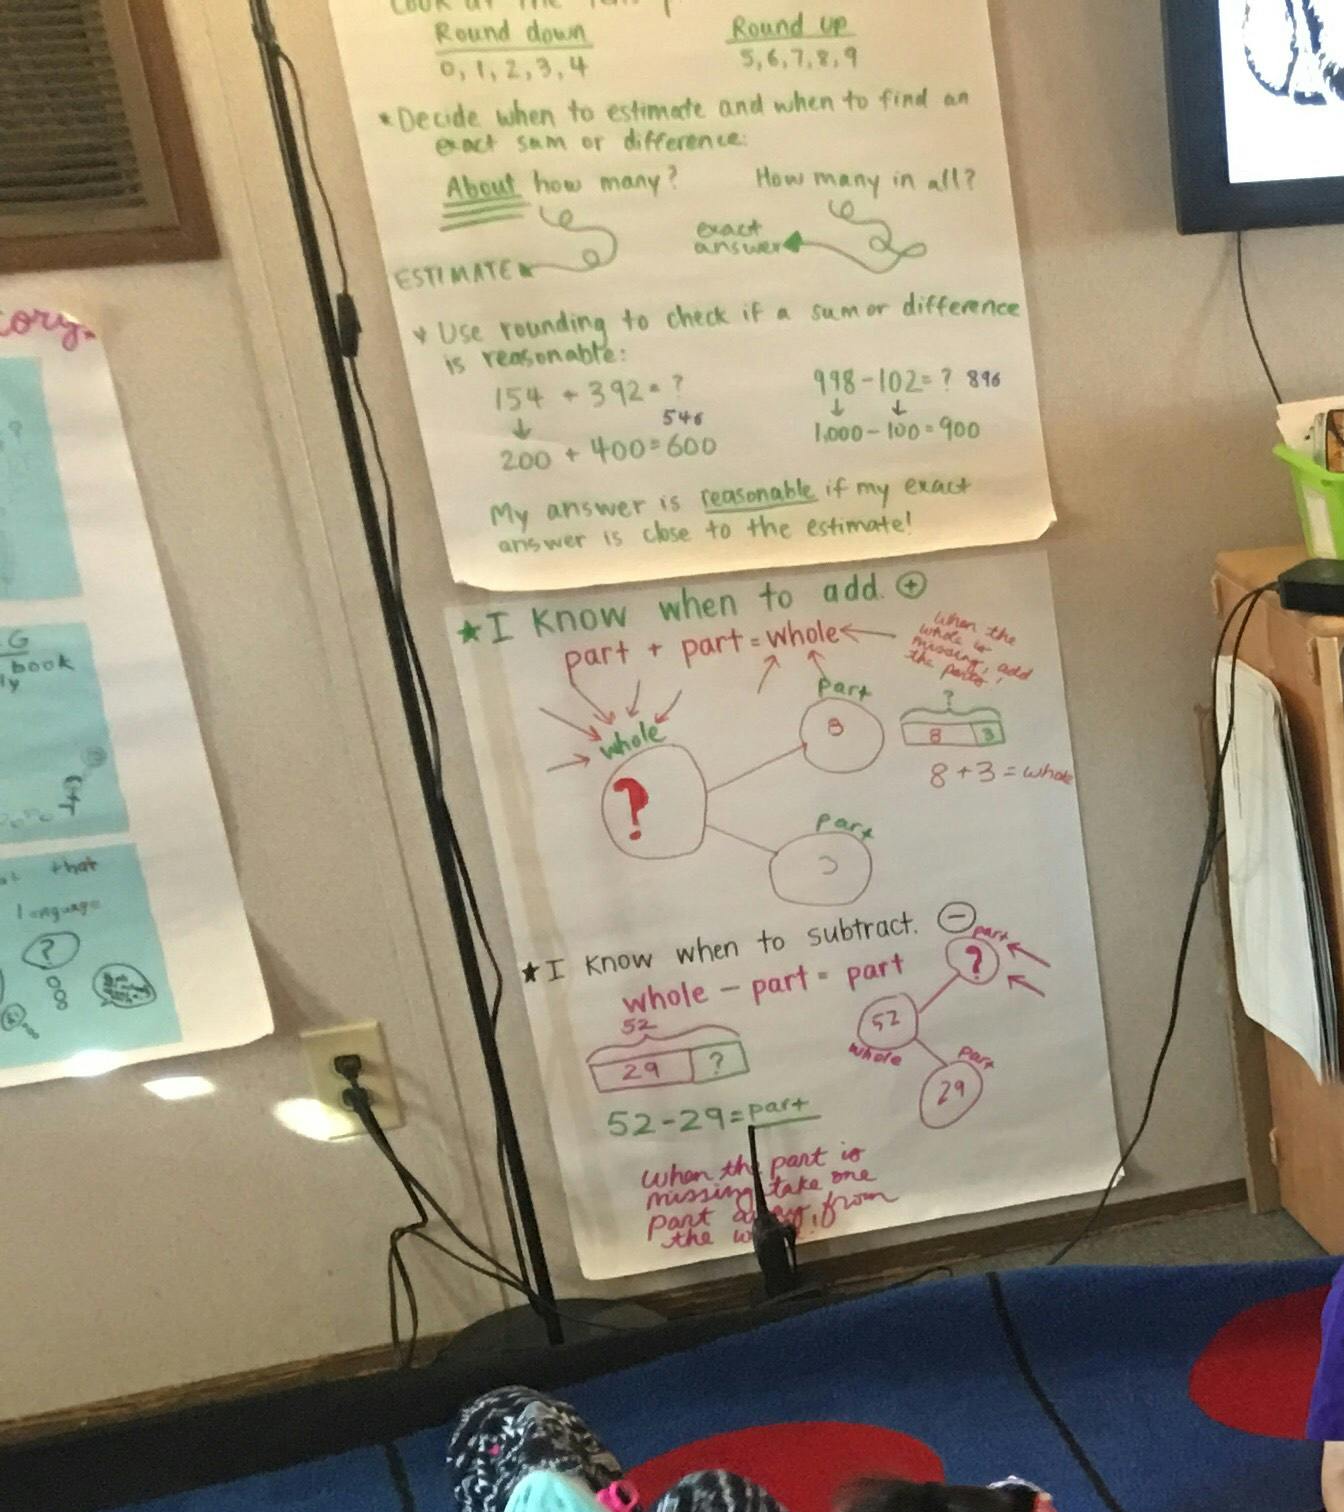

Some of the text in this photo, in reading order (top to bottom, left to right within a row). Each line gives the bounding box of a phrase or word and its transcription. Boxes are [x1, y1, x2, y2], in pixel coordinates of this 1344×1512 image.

[434, 18, 587, 45] Round down
[732, 12, 848, 40] Round up
[397, 87, 969, 132] Decide when to estimate and when to find an
[435, 133, 497, 156] exact
[517, 136, 567, 152] sum
[581, 135, 603, 153] or
[445, 172, 516, 200] About
[533, 169, 583, 195] how
[756, 166, 805, 188] How
[813, 170, 881, 200] many
[893, 170, 915, 190] in
[694, 219, 782, 255] exact answer
[393, 259, 514, 291] ESTIMATE
[438, 291, 1021, 351] Use rounding to check if a sum or difference
[445, 355, 467, 376] is
[489, 477, 972, 533] My answer is reasonable if my exact
[498, 533, 587, 554] answer
[603, 529, 624, 547] is
[642, 519, 692, 544] close
[706, 519, 732, 541] to
[750, 515, 793, 540] the
[658, 586, 738, 623] when
[758, 581, 793, 612] to
[564, 619, 841, 675] part part whole
[818, 677, 872, 701] part
[599, 720, 666, 760] whole
[815, 812, 874, 840] part
[676, 936, 739, 966] when
[757, 929, 786, 955] to
[622, 952, 905, 1014] whole part part
[622, 1060, 661, 1081] 29
[847, 1042, 903, 1067] whole
[957, 1045, 996, 1071] part
[937, 1079, 965, 1106] 29
[769, 1147, 827, 1178] part
[645, 1182, 755, 1213] missing
[763, 1176, 823, 1199] take
[647, 1206, 717, 1242] part
[821, 1190, 901, 1229] from
[661, 1227, 715, 1250] the
